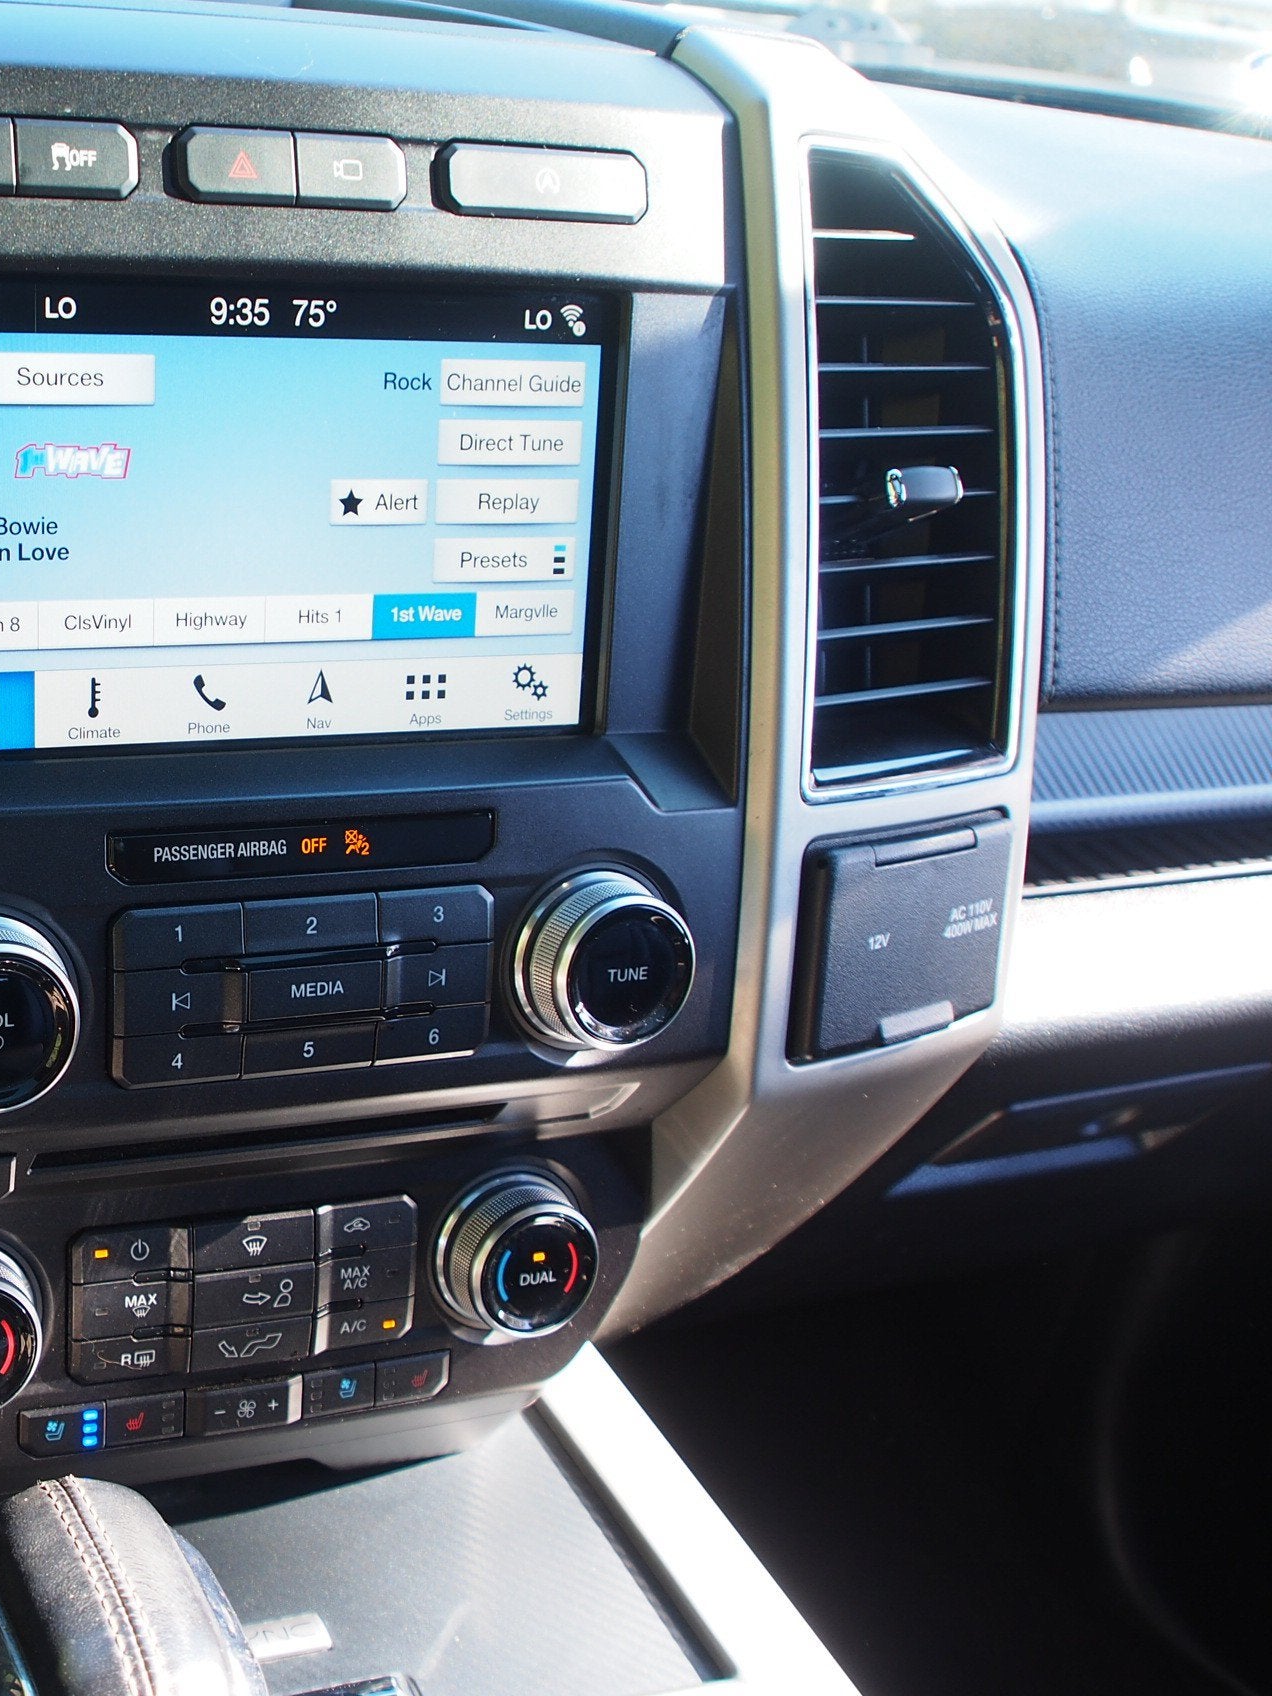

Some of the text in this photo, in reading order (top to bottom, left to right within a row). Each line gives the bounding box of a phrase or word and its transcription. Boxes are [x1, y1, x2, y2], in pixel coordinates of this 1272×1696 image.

[68, 149, 97, 167] OFF
[44, 296, 77, 320] LO
[210, 297, 270, 327] 9:35
[524, 309, 552, 330] LO
[16, 366, 104, 388] Sources
[383, 372, 432, 391] Rock
[446, 372, 582, 393] Channel Guide
[460, 433, 564, 452] Direct Tune
[374, 493, 418, 511] Alert
[478, 493, 540, 514] Replay
[18, 543, 70, 562] Love
[460, 550, 528, 569] Presets
[176, 611, 248, 631] Highway
[298, 608, 342, 625] Hits 1
[391, 605, 462, 622] 1st Wave
[495, 603, 558, 622] Margvlle
[9, 616, 21, 632] 8
[64, 613, 132, 633] ClsVinyl
[306, 717, 332, 730] Nav
[409, 712, 442, 727] Apps
[504, 707, 553, 722] Settings
[68, 726, 121, 741] Climate
[187, 721, 230, 735] Phone
[153, 843, 235, 863] PASSENGER
[237, 839, 287, 858] AIRBAG
[301, 836, 327, 855] OFF
[433, 906, 444, 923] 3
[949, 898, 993, 922] AC 110V
[306, 917, 317, 935] 2
[973, 911, 998, 931] MAX
[174, 925, 183, 942] 1
[868, 932, 891, 950] 12V
[608, 966, 649, 983] TUNE
[291, 980, 344, 999] MEDIA
[428, 1028, 439, 1045] 6
[302, 1041, 315, 1058] 5
[171, 1053, 183, 1069] 4
[340, 1265, 371, 1282] MAX
[519, 1270, 556, 1287] DUAL
[343, 1276, 368, 1291] A/C
[124, 1293, 158, 1308] MAX
[340, 1319, 367, 1334] A/C
[121, 1353, 132, 1366] R
